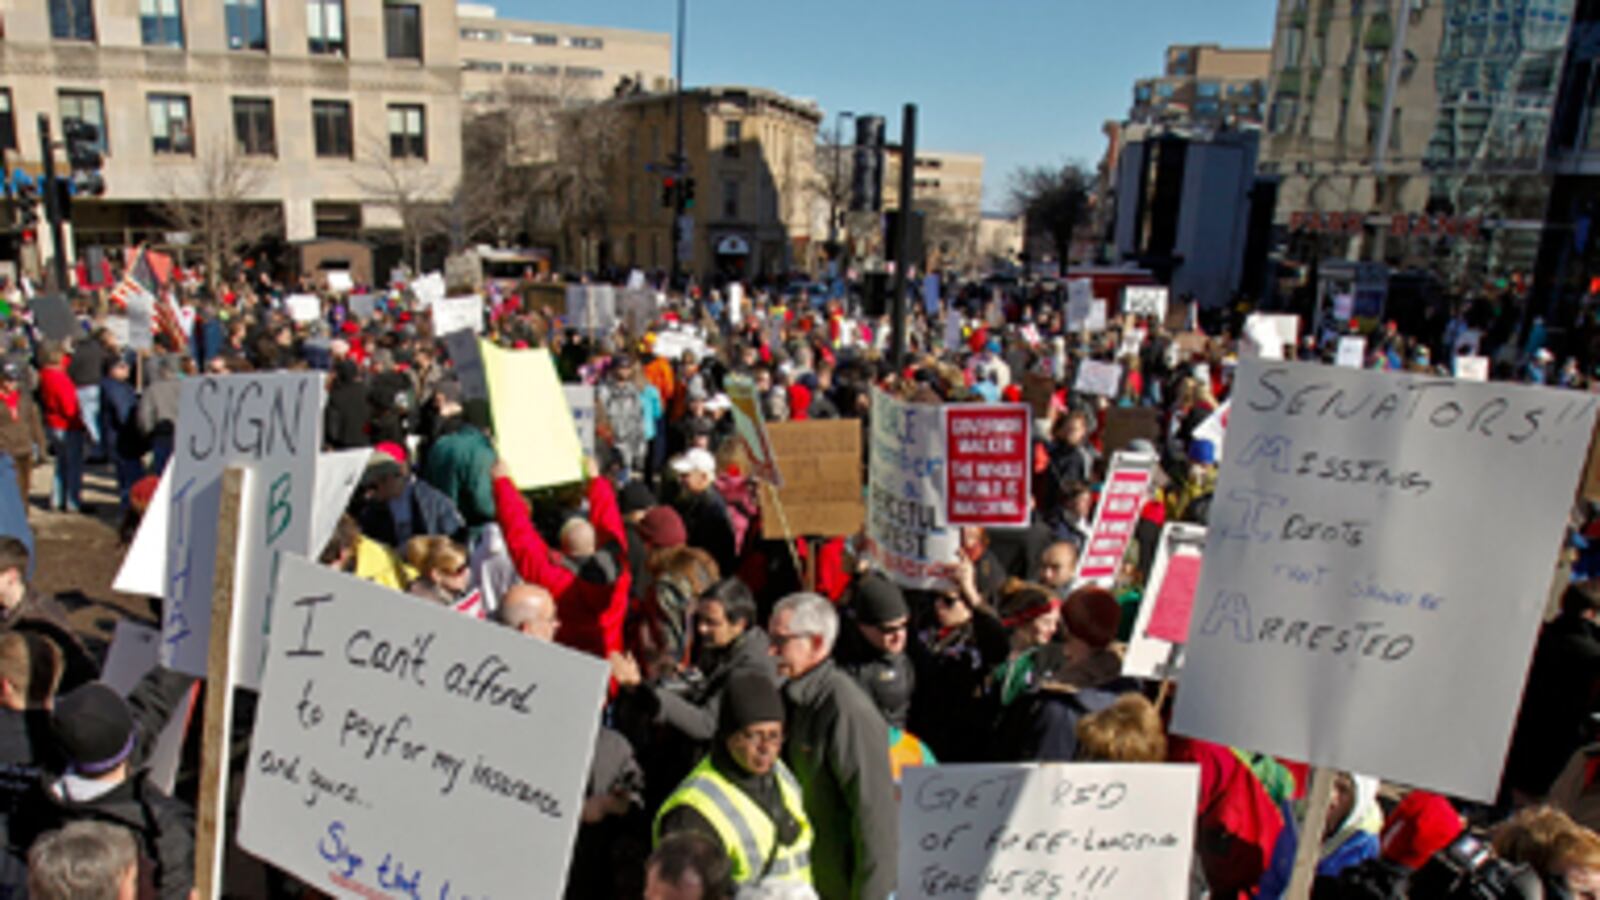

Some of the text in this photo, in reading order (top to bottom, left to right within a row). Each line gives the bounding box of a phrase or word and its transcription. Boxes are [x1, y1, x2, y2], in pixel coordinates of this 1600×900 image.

[1290, 211, 1482, 239] PARK BANK
[189, 377, 307, 461] SIGN
[1248, 368, 1596, 444] SENATORS!!
[286, 594, 537, 714] I can't afford
[1201, 590, 1414, 661] ARRESTED
[259, 749, 302, 786] and
[295, 680, 324, 730] to
[431, 750, 467, 797] my
[470, 755, 564, 820] insurance
[914, 774, 1127, 812] GET RID
[318, 820, 363, 879] Sign
[919, 823, 973, 851] OF
